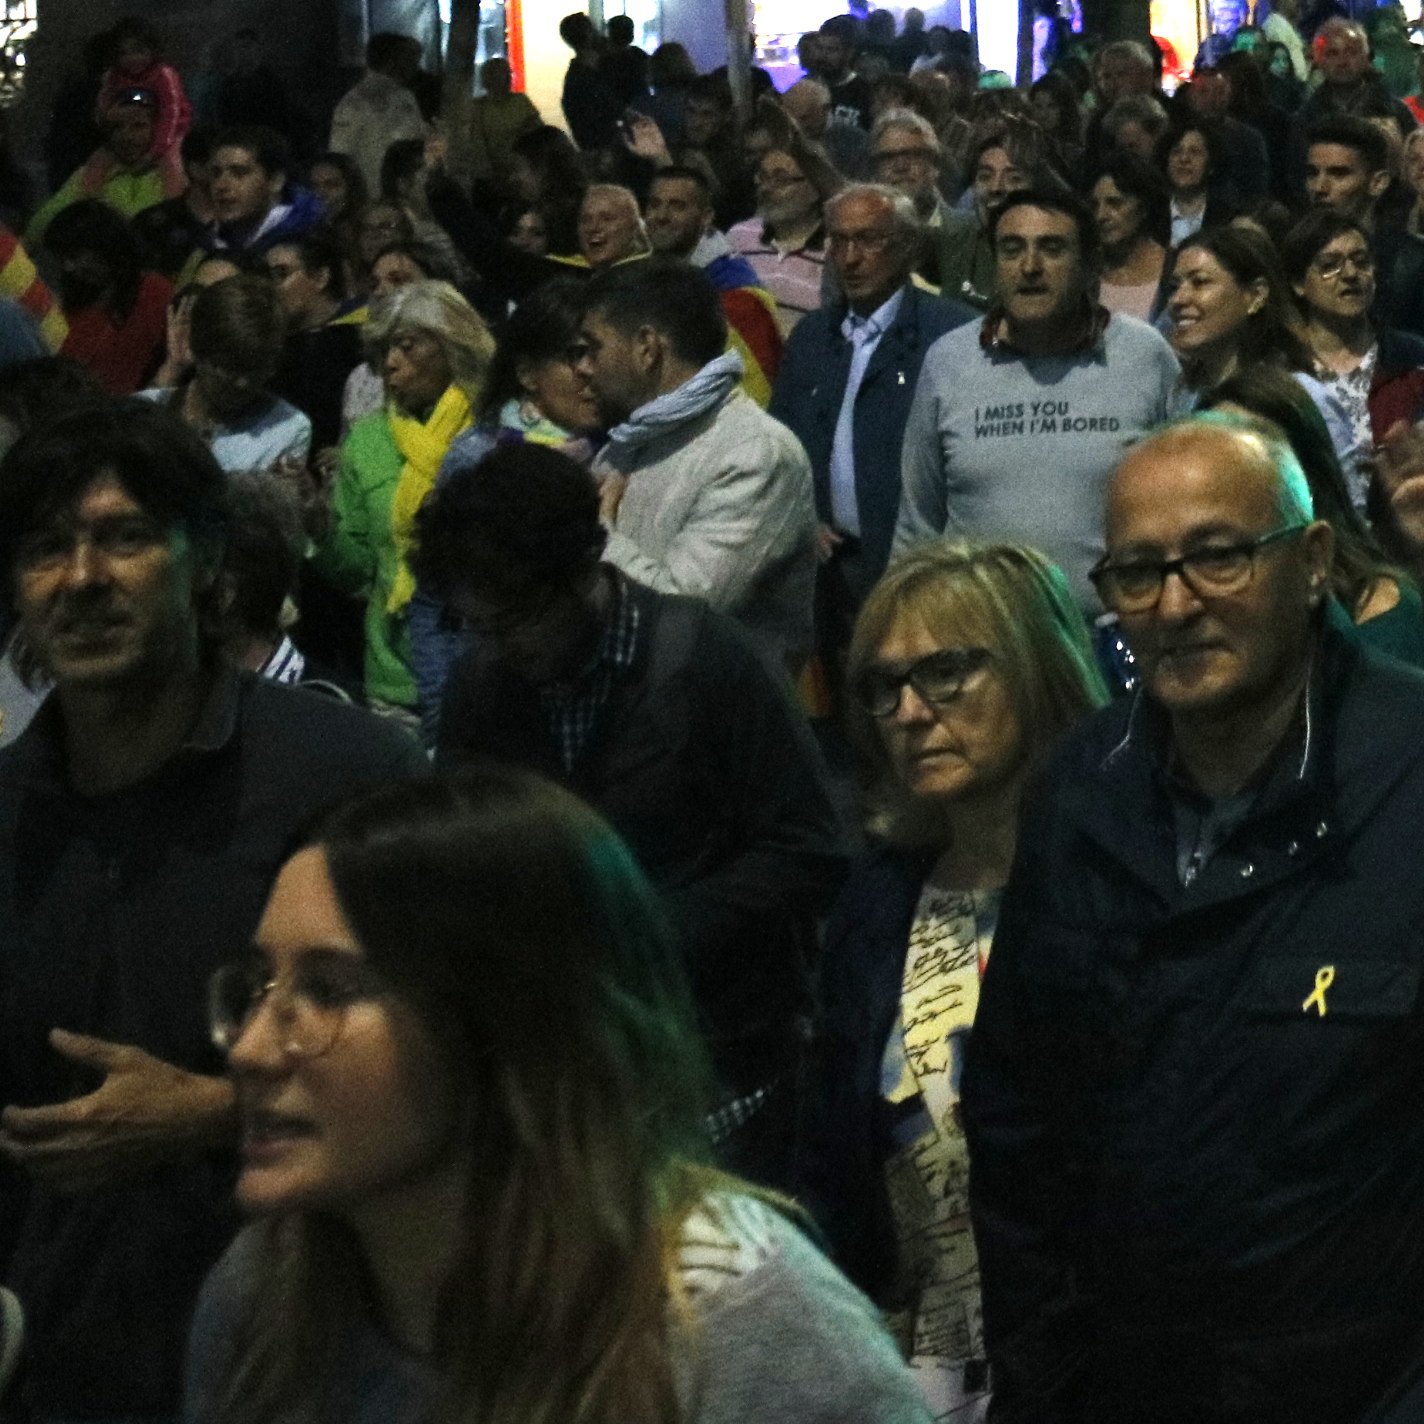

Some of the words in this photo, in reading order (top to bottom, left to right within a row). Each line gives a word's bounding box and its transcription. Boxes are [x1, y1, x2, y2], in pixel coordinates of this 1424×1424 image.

[974, 406, 980, 423] I
[984, 403, 1024, 421] MISS
[1030, 401, 1070, 417] YOU
[974, 420, 1024, 439] WHEN
[1030, 418, 1057, 435] I'M
[1062, 417, 1120, 433] BORED
